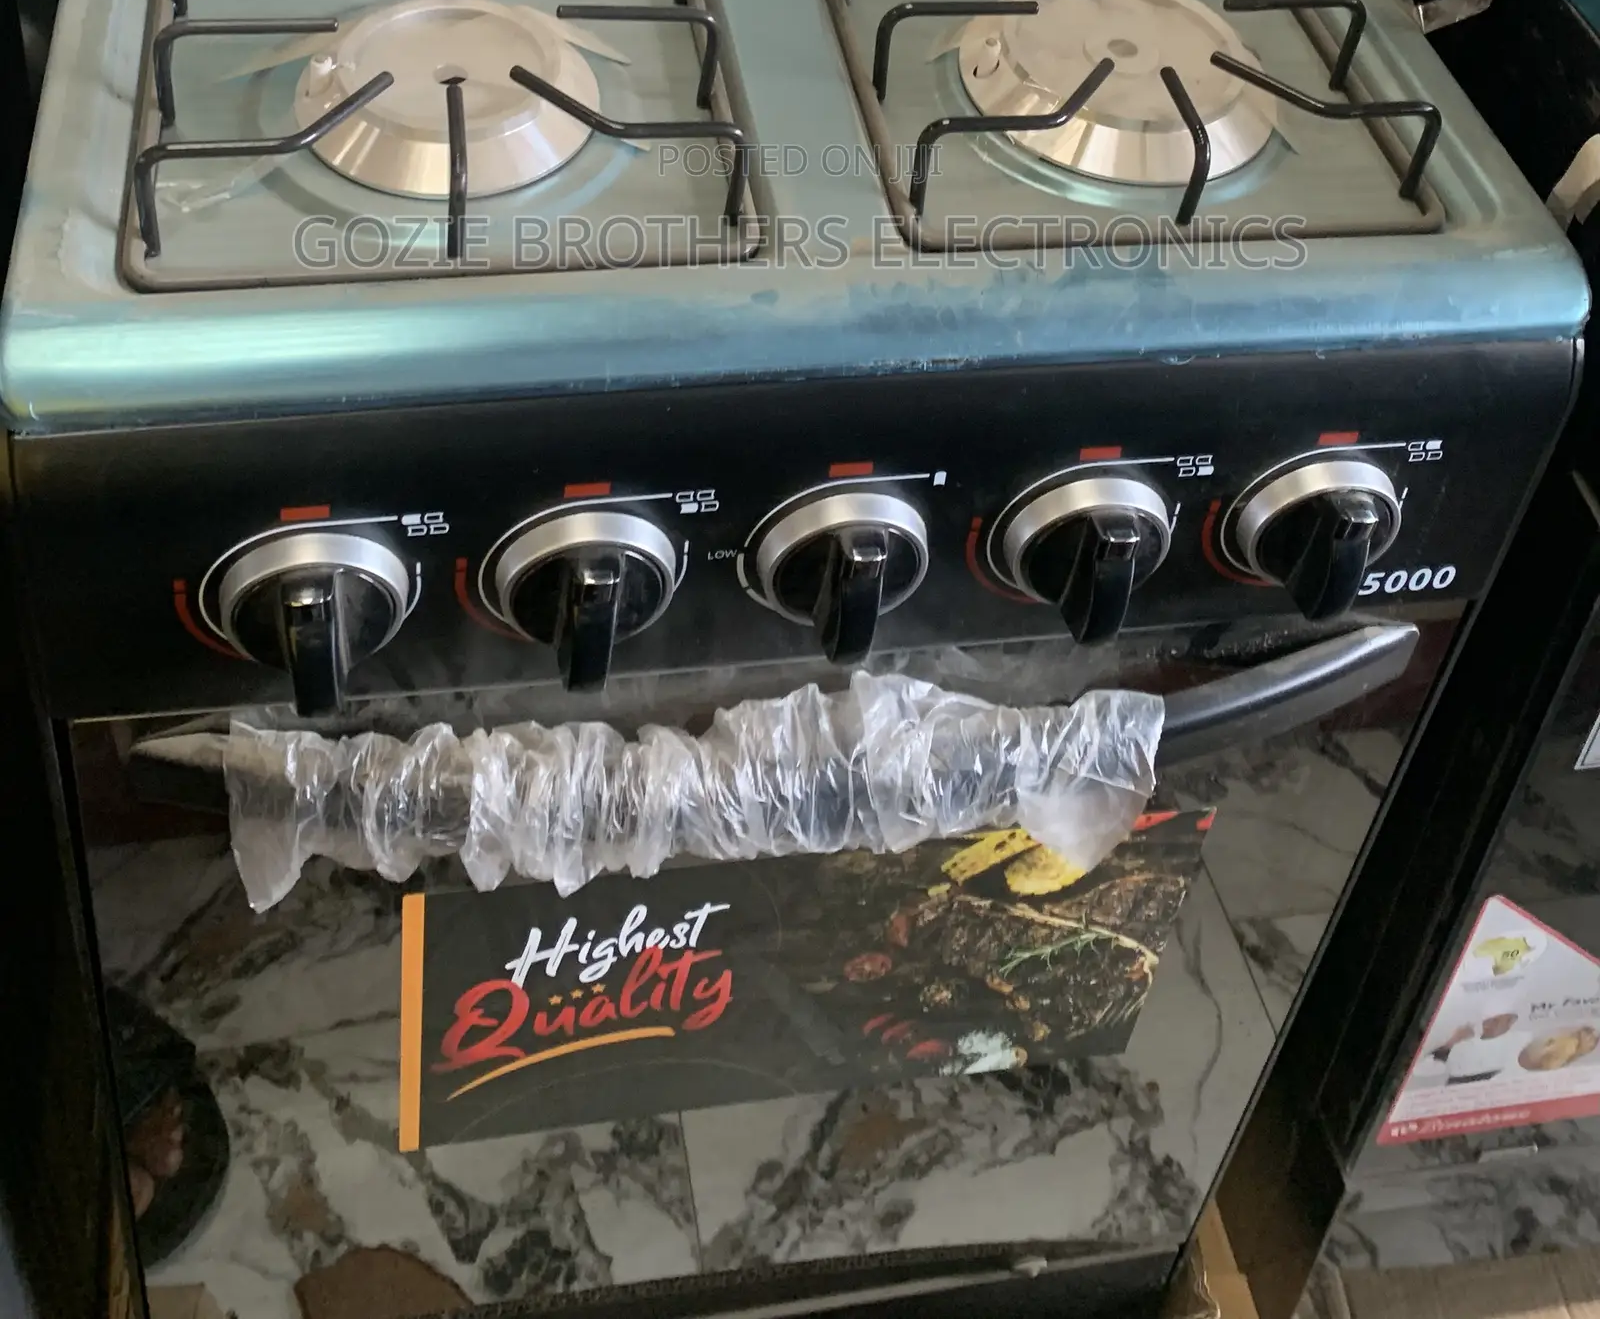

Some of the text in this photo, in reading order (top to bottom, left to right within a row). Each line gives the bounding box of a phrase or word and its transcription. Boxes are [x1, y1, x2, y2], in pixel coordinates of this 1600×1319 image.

[708, 549, 737, 561] LOW
[1358, 565, 1456, 595] 5000
[505, 901, 730, 989] Highest
[430, 945, 733, 1075] Quality
